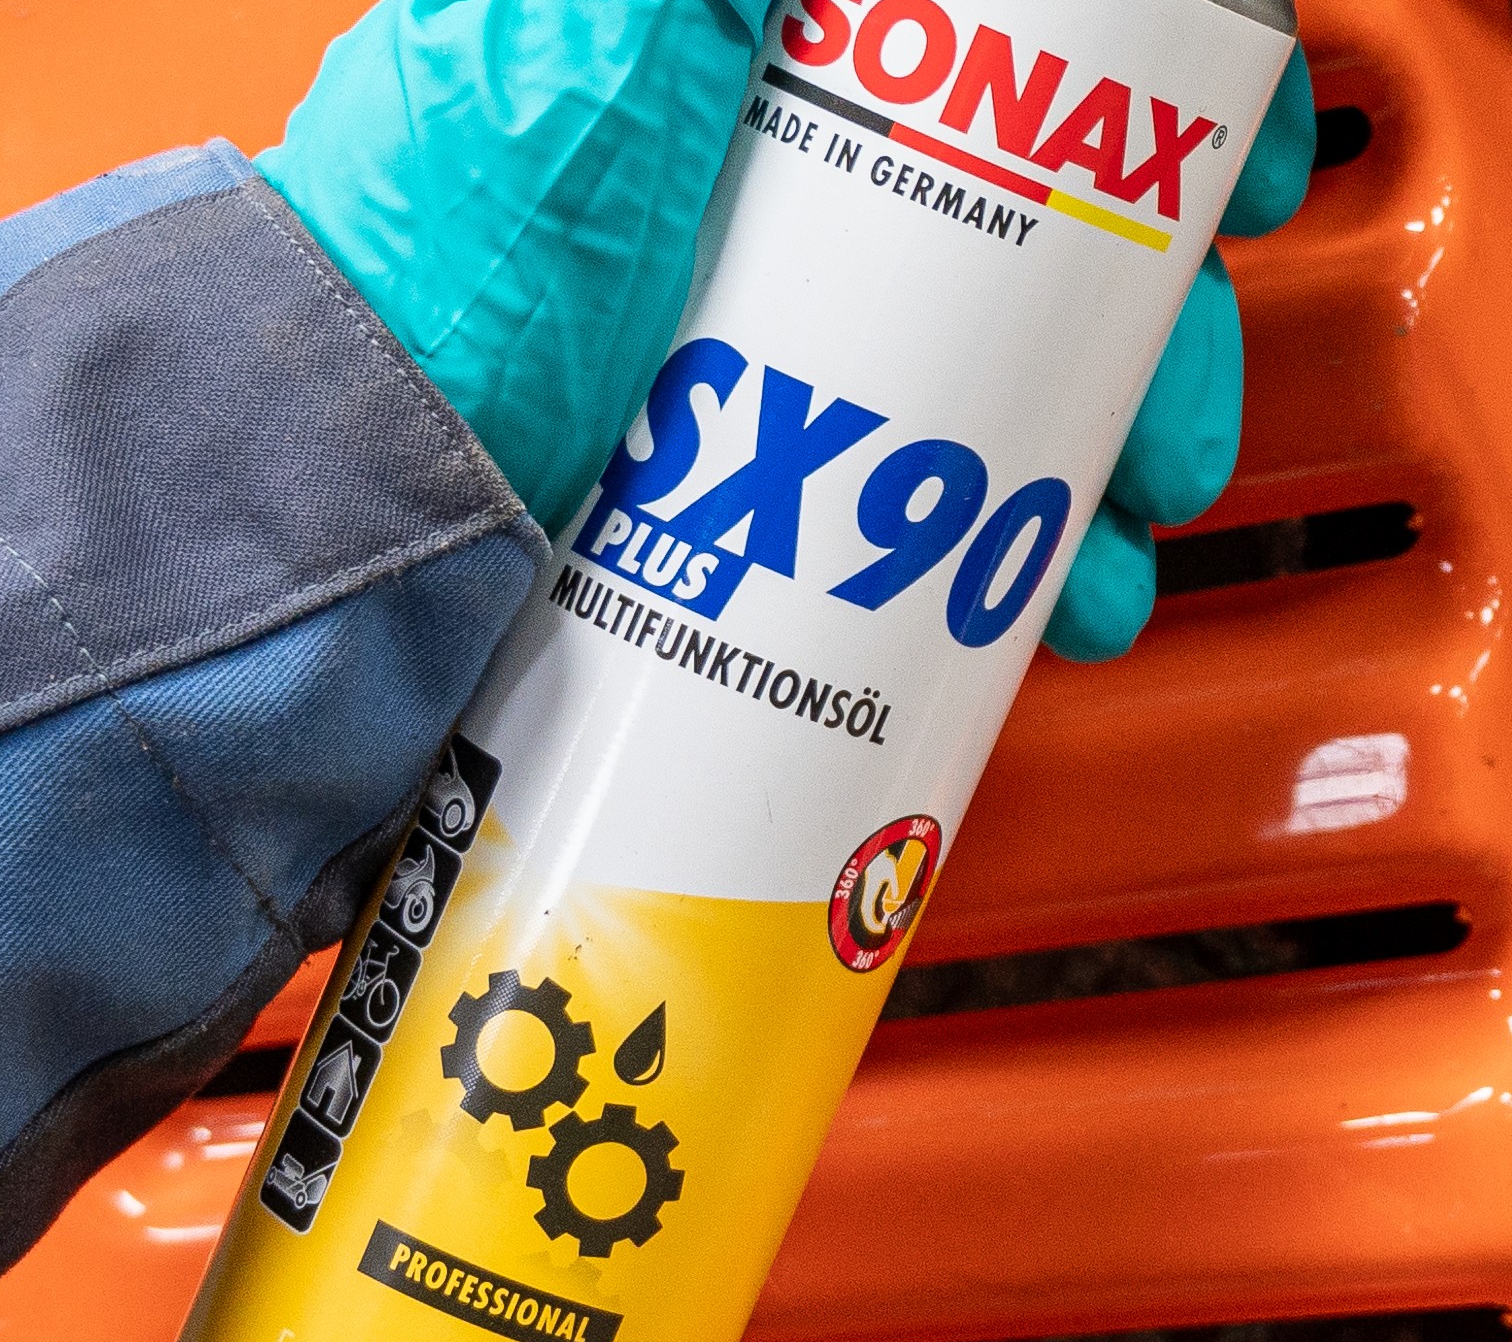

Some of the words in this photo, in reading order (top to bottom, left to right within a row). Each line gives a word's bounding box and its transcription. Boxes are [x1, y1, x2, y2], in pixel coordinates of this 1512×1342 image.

[743, 95, 812, 155] MADE
[826, 134, 863, 174] IN
[870, 154, 1039, 249] GERMANY
[590, 507, 720, 601] PLUS
[549, 563, 893, 747] MULTIFUNKTIONSÖL
